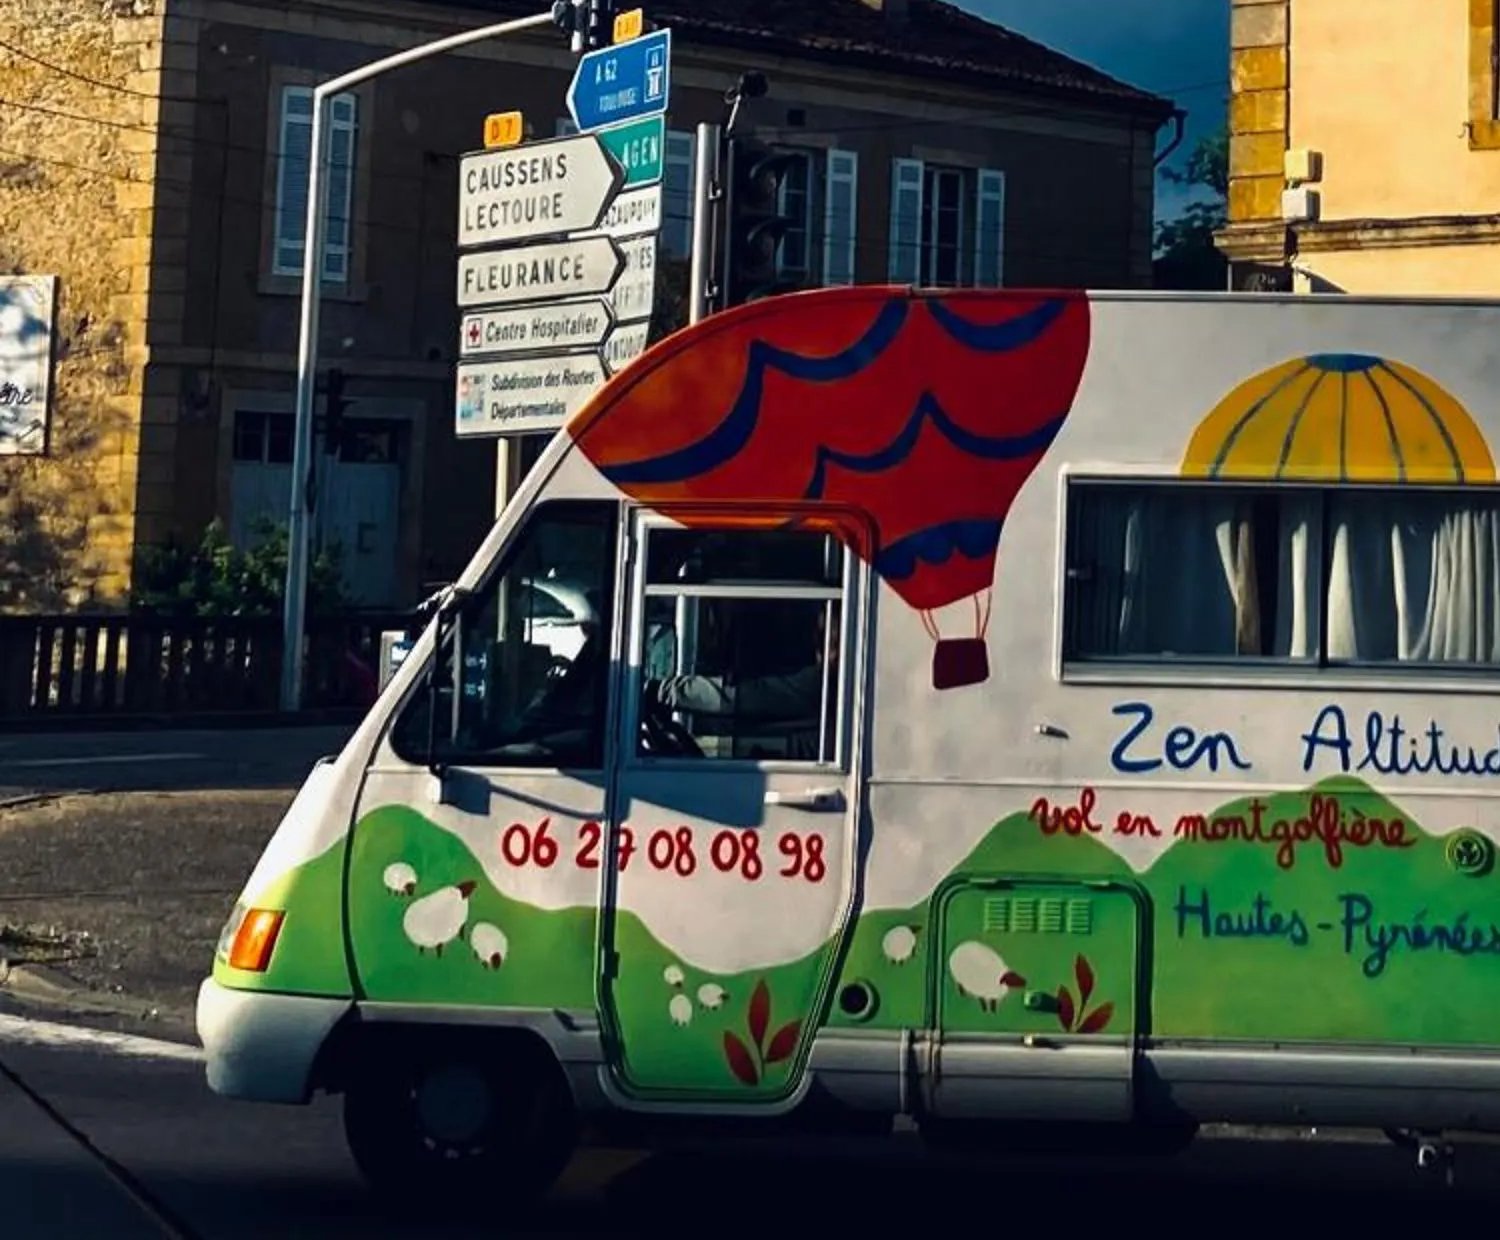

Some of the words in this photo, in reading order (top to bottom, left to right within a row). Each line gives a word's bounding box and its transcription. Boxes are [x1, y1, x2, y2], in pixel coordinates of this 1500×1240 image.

[491, 121, 499, 141] D
[504, 119, 513, 138] 7
[622, 136, 658, 168] AGEN
[467, 153, 568, 194] CAUSSENS
[465, 193, 563, 231] LECTOURE
[464, 254, 584, 294] FLEURANCE
[486, 321, 527, 342] Centre
[531, 312, 599, 340] Hospitalier
[491, 372, 543, 391] Subdivision
[544, 371, 561, 388] des
[562, 368, 596, 385] Routes
[1111, 702, 1252, 772] Zen
[1029, 786, 1102, 836] vol
[1113, 808, 1161, 837] en
[1175, 792, 1417, 868] montgolfière
[502, 817, 558, 867] 06
[648, 825, 697, 877] 08
[710, 829, 763, 881] 08
[778, 832, 826, 883] 98
